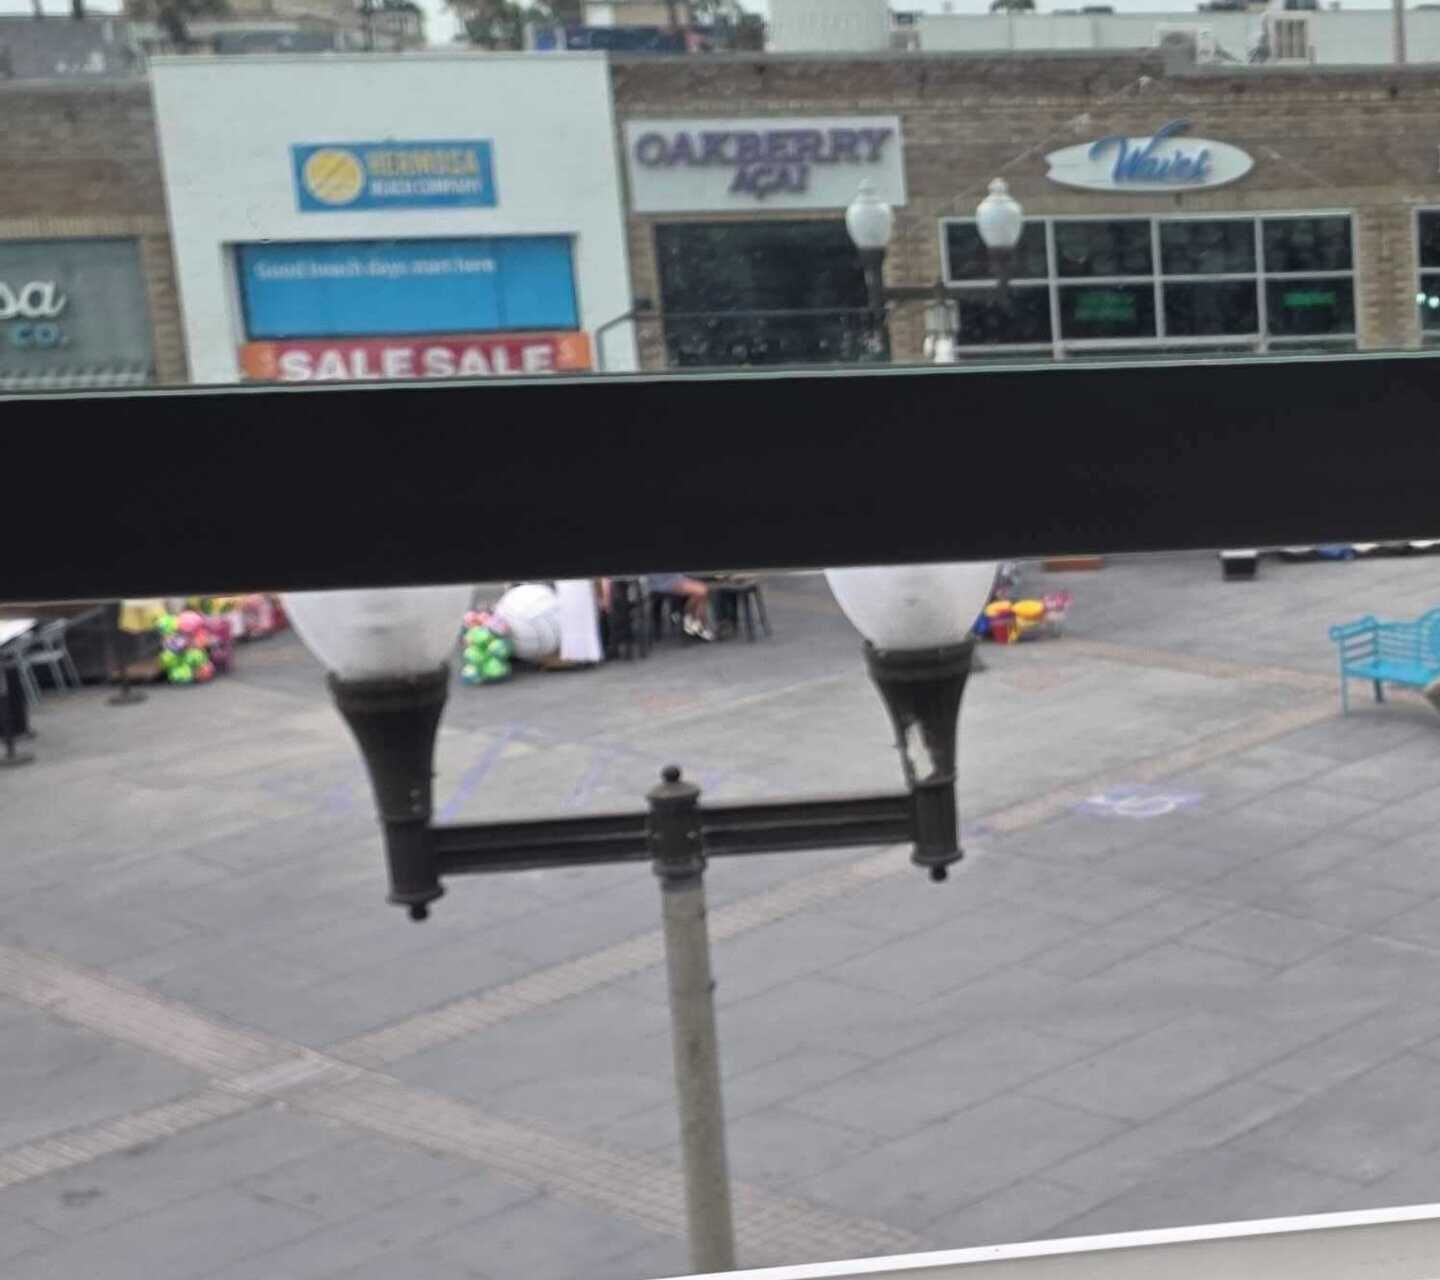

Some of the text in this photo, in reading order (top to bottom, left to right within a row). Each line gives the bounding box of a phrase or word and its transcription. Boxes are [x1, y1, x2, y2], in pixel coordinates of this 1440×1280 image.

[635, 127, 894, 166] OAKBERRY
[278, 342, 554, 382] SALE SALE
